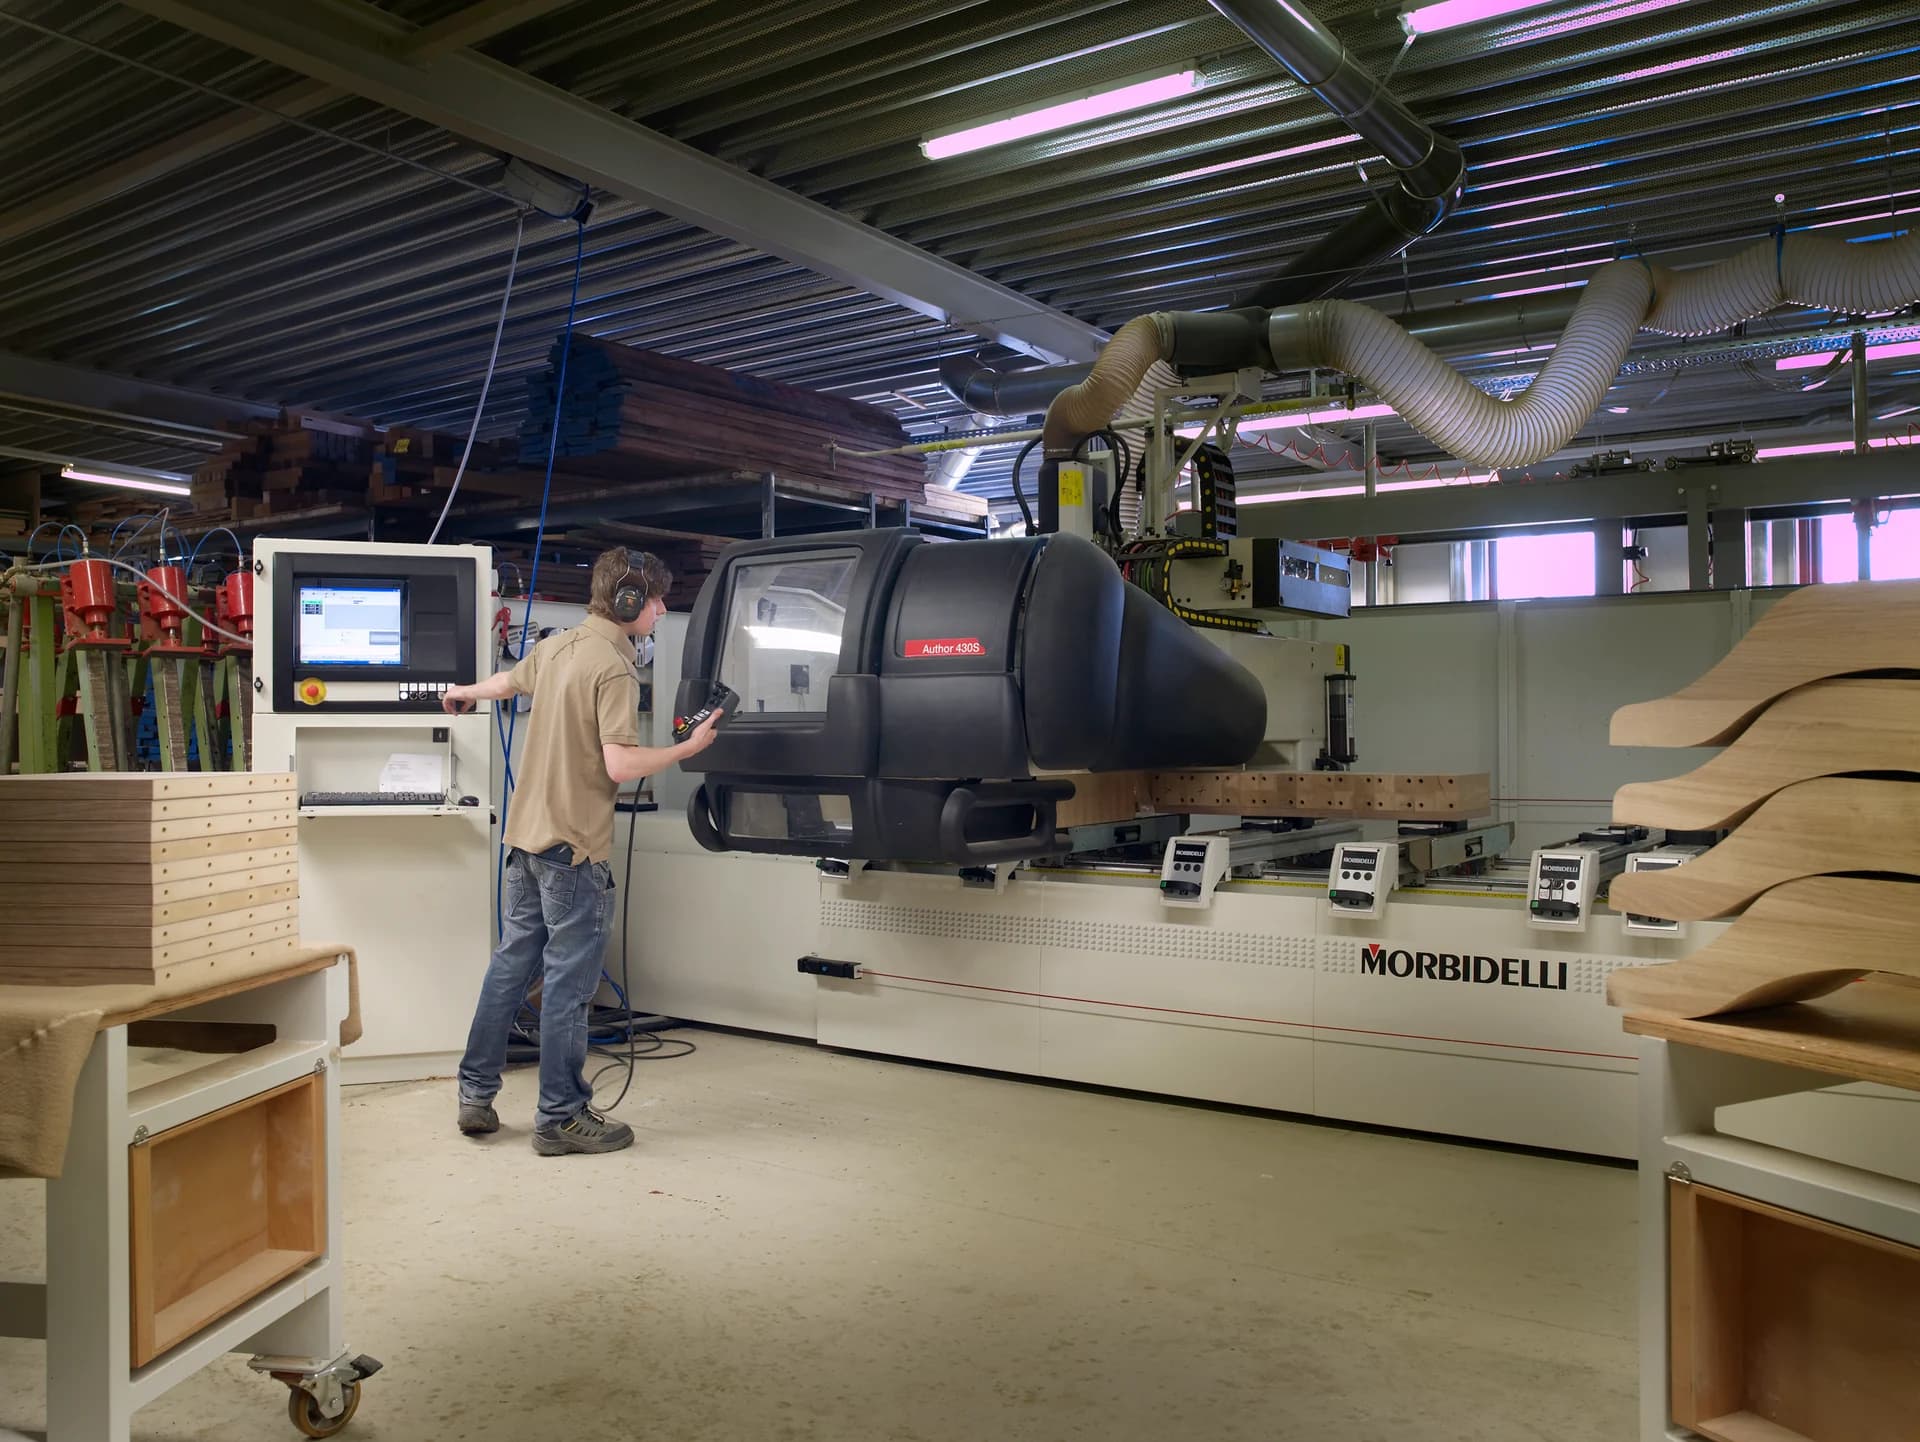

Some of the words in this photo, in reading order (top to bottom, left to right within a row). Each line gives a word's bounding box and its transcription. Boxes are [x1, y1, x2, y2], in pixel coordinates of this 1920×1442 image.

[922, 643, 954, 654] Author
[955, 642, 980, 653] 430S
[1361, 945, 1567, 990] MORBIDELLI
